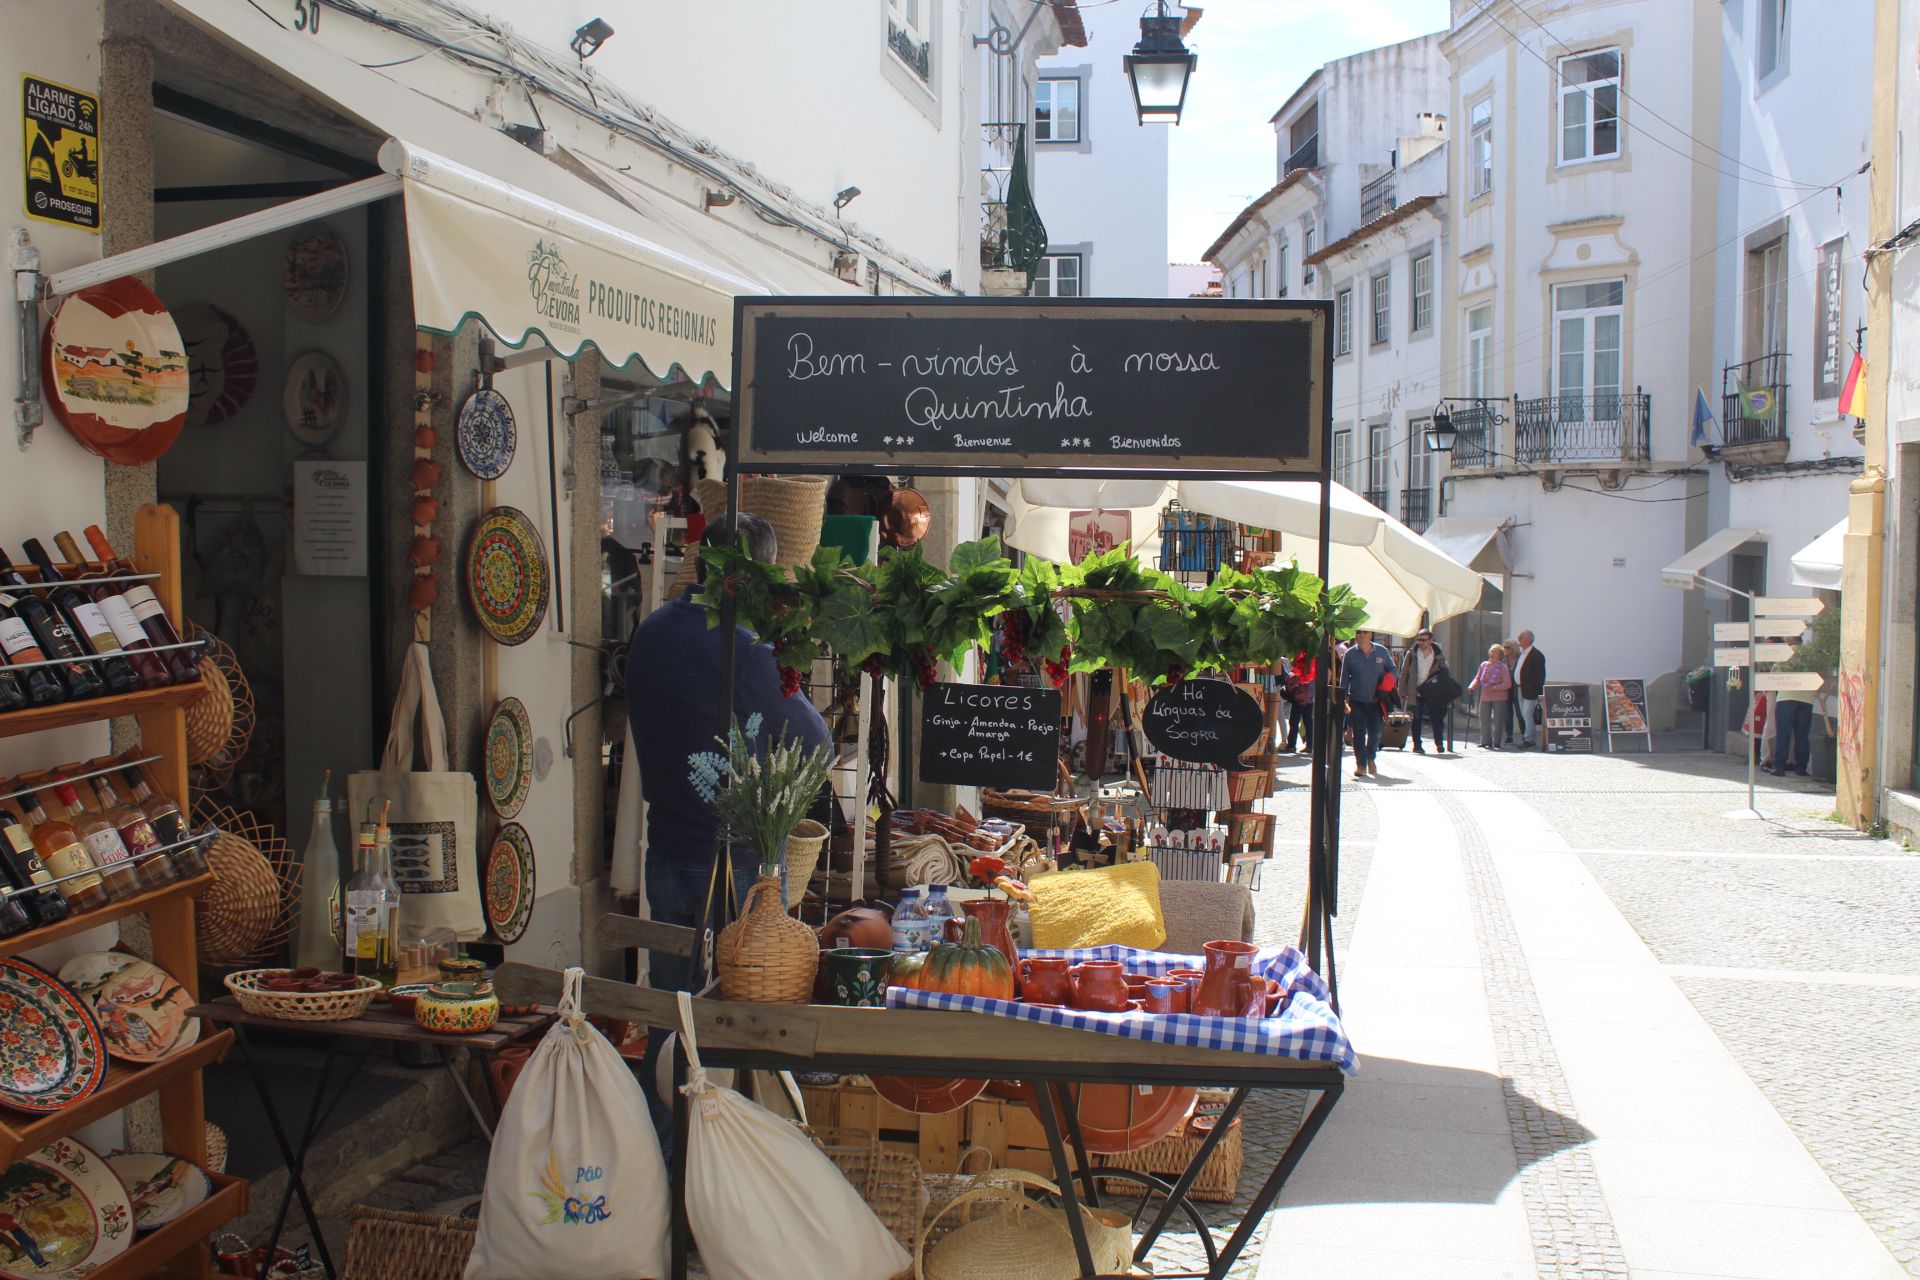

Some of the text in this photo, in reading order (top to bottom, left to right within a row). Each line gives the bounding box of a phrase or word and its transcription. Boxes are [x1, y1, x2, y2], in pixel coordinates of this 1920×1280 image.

[28, 83, 76, 108] ALARME
[27, 95, 76, 122] LIGADO
[78, 119, 94, 133] 24h
[49, 197, 92, 216] PROSEGUR
[549, 292, 580, 325] ÉVORA
[589, 279, 717, 347] PRODUTOS REGIONAIS
[788, 332, 866, 380] Bem
[902, 344, 1019, 377] vindos
[1070, 344, 1093, 374] à
[1124, 352, 1220, 373] nossa
[905, 381, 1093, 431] Quintinha
[796, 426, 1182, 449] Welcome Bienvenue Bienvenidos
[944, 688, 1032, 710] Licores
[1182, 683, 1206, 700] Há
[1152, 700, 1233, 723] Línguas da
[932, 714, 1054, 735] Ginja Amendoa Poejo
[967, 726, 1010, 742] Amarga
[949, 748, 974, 762] Copo
[978, 746, 1006, 763] Papel
[1016, 751, 1033, 762] 1€
